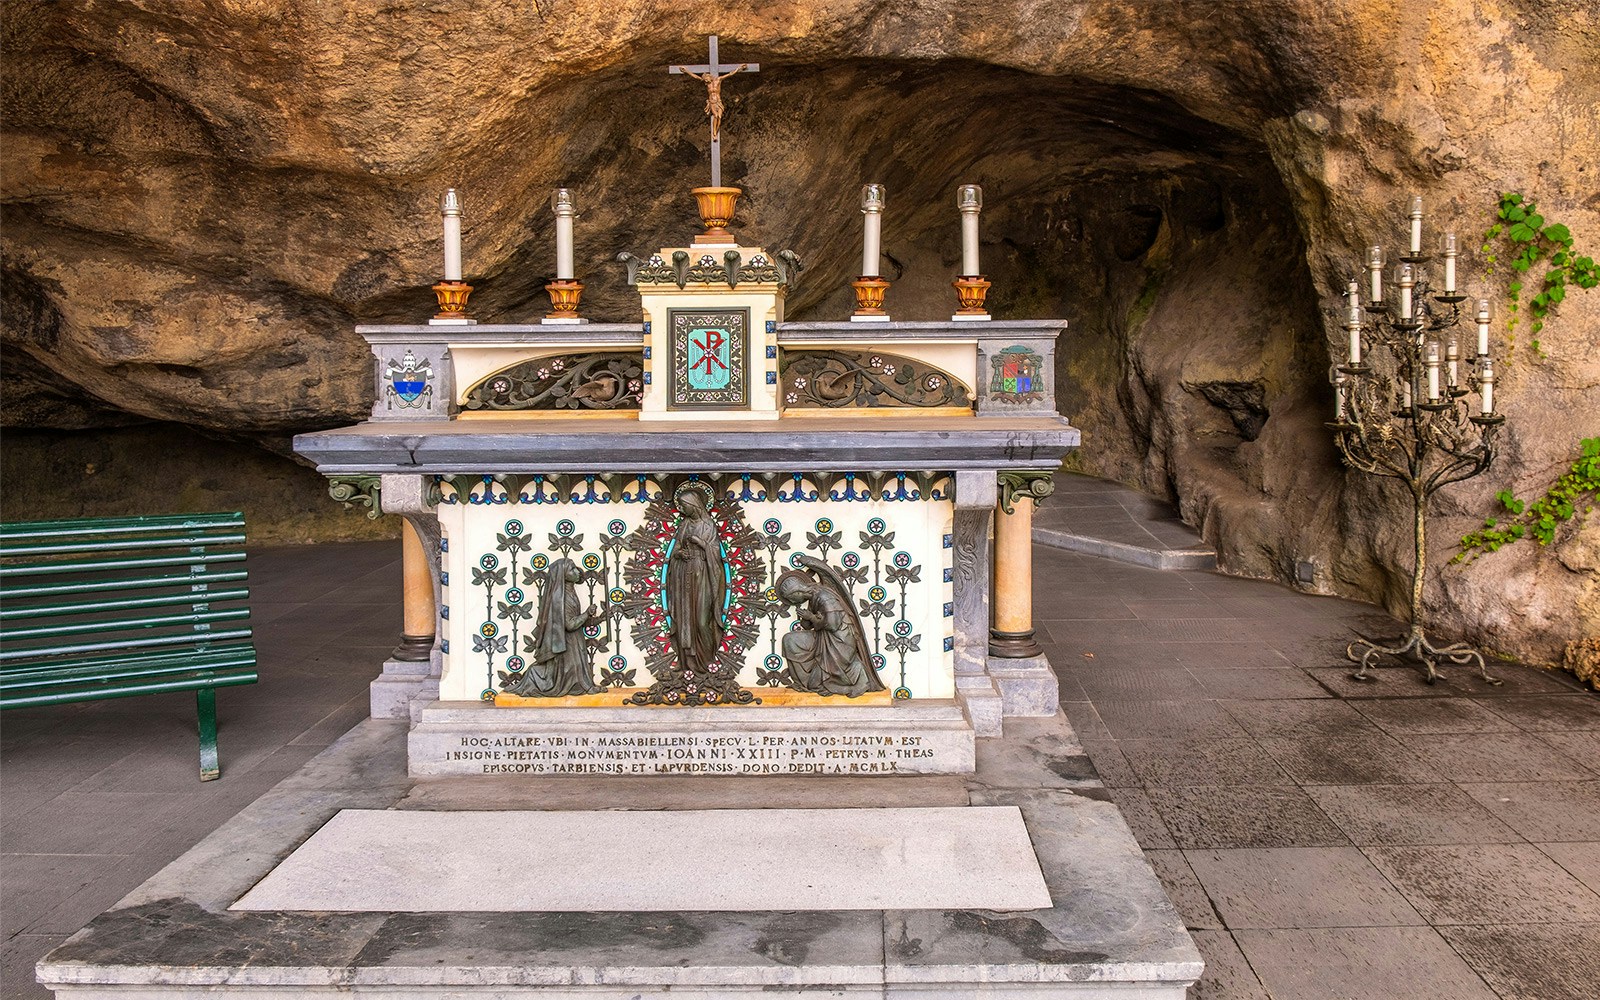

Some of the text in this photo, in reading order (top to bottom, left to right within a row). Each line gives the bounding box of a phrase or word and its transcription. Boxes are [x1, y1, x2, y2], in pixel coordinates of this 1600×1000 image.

[461, 736, 922, 747] HOC ALTARE VBI IN MASSABIELLENSI SPECV L PER ANNOS LITATVM EST
[446, 748, 934, 760] INSIGNE PIETATIS MONVMENTVM IOANNI XXIII P M PETRVS M THEAS
[483, 761, 897, 774] EPISCOPVS TARBIENSIS ET LAPVRDENSIS DONO DEDIT A MCMLX
